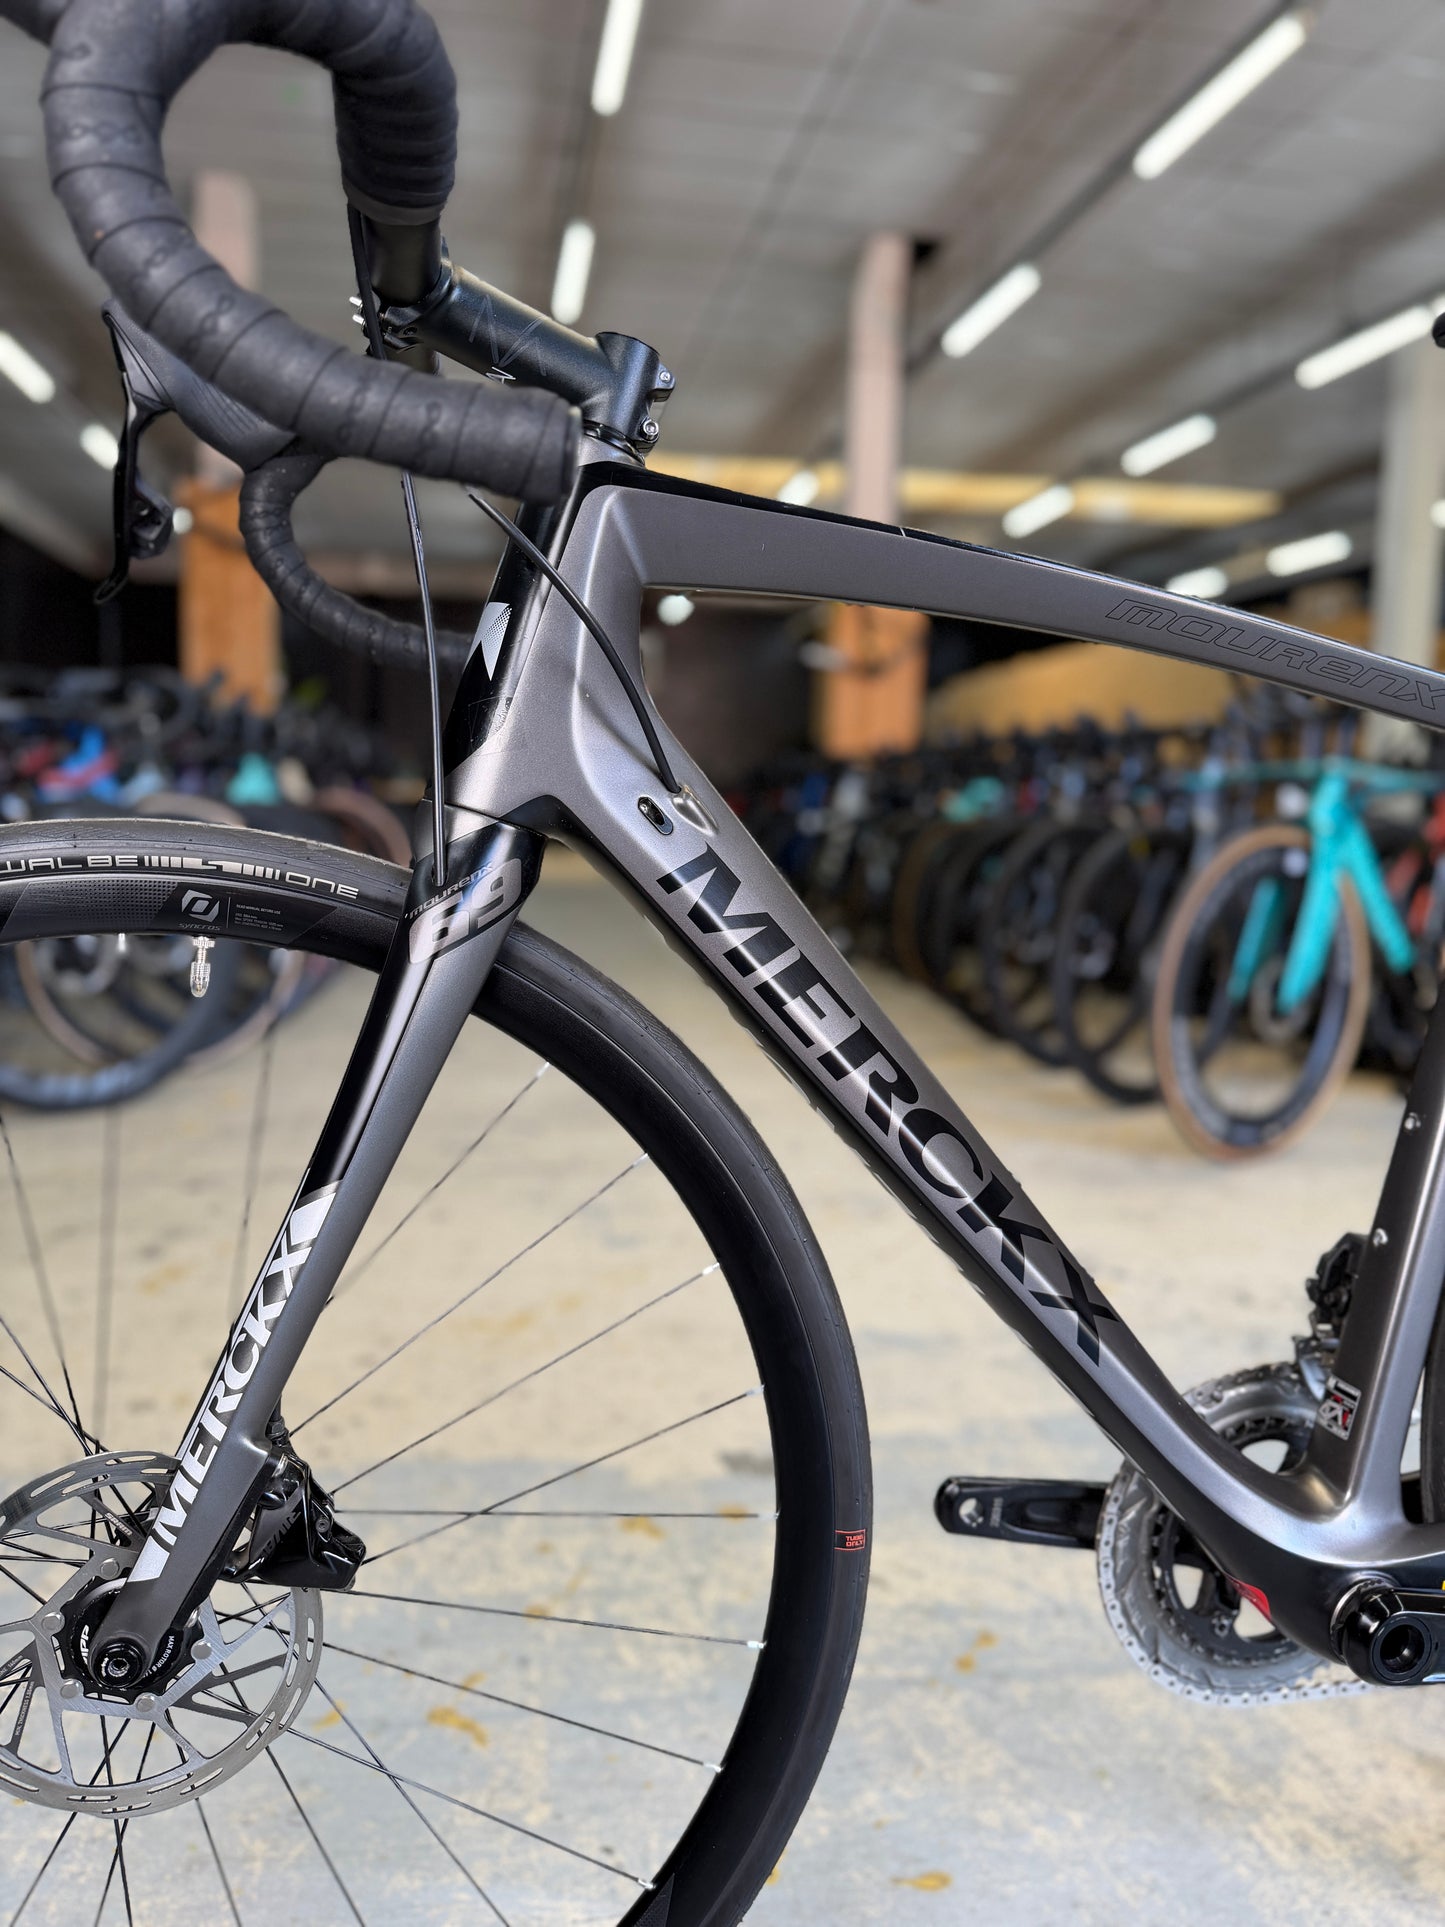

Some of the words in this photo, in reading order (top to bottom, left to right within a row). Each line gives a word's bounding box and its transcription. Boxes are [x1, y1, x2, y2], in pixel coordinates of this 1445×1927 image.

[178, 922, 221, 931] syncros
[409, 858, 522, 964] 69
[655, 840, 1119, 1367] MERCKX
[151, 1229, 313, 1546] MERCKX
[156, 1649, 172, 1668] ROTOR
